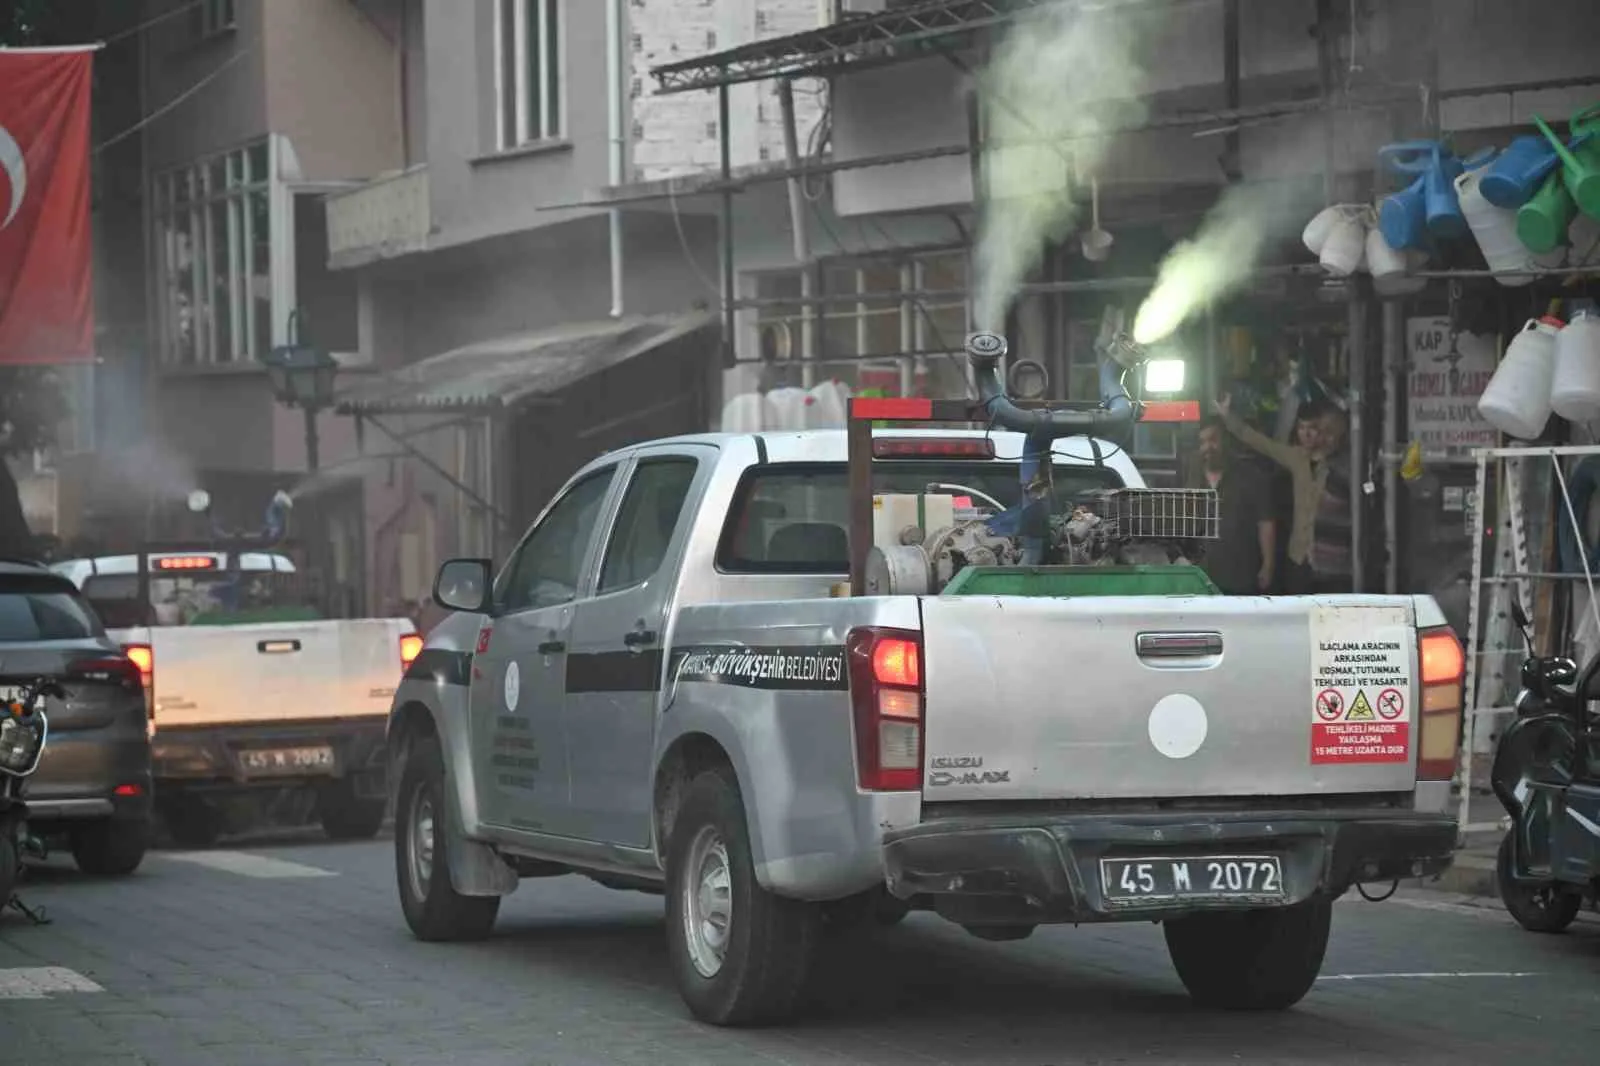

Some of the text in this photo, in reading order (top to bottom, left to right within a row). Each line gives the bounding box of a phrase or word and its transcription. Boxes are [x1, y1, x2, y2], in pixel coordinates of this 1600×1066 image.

[1334, 655, 1388, 663] ARKASINDAN
[712, 648, 785, 684] BÜYÜKŞEHİR
[785, 652, 844, 682] BELEDİYESİ
[1314, 677, 1409, 687] TEHLİKELİ VE YASAKTIR
[1368, 724, 1397, 733] MADDE
[1326, 747, 1353, 756] METRE
[1355, 746, 1386, 755] UZAKTA
[1387, 745, 1405, 754] DUR
[931, 755, 983, 768] ISUZU
[929, 770, 1010, 787] D-MAX
[1120, 861, 1278, 893] 45 M 2072
